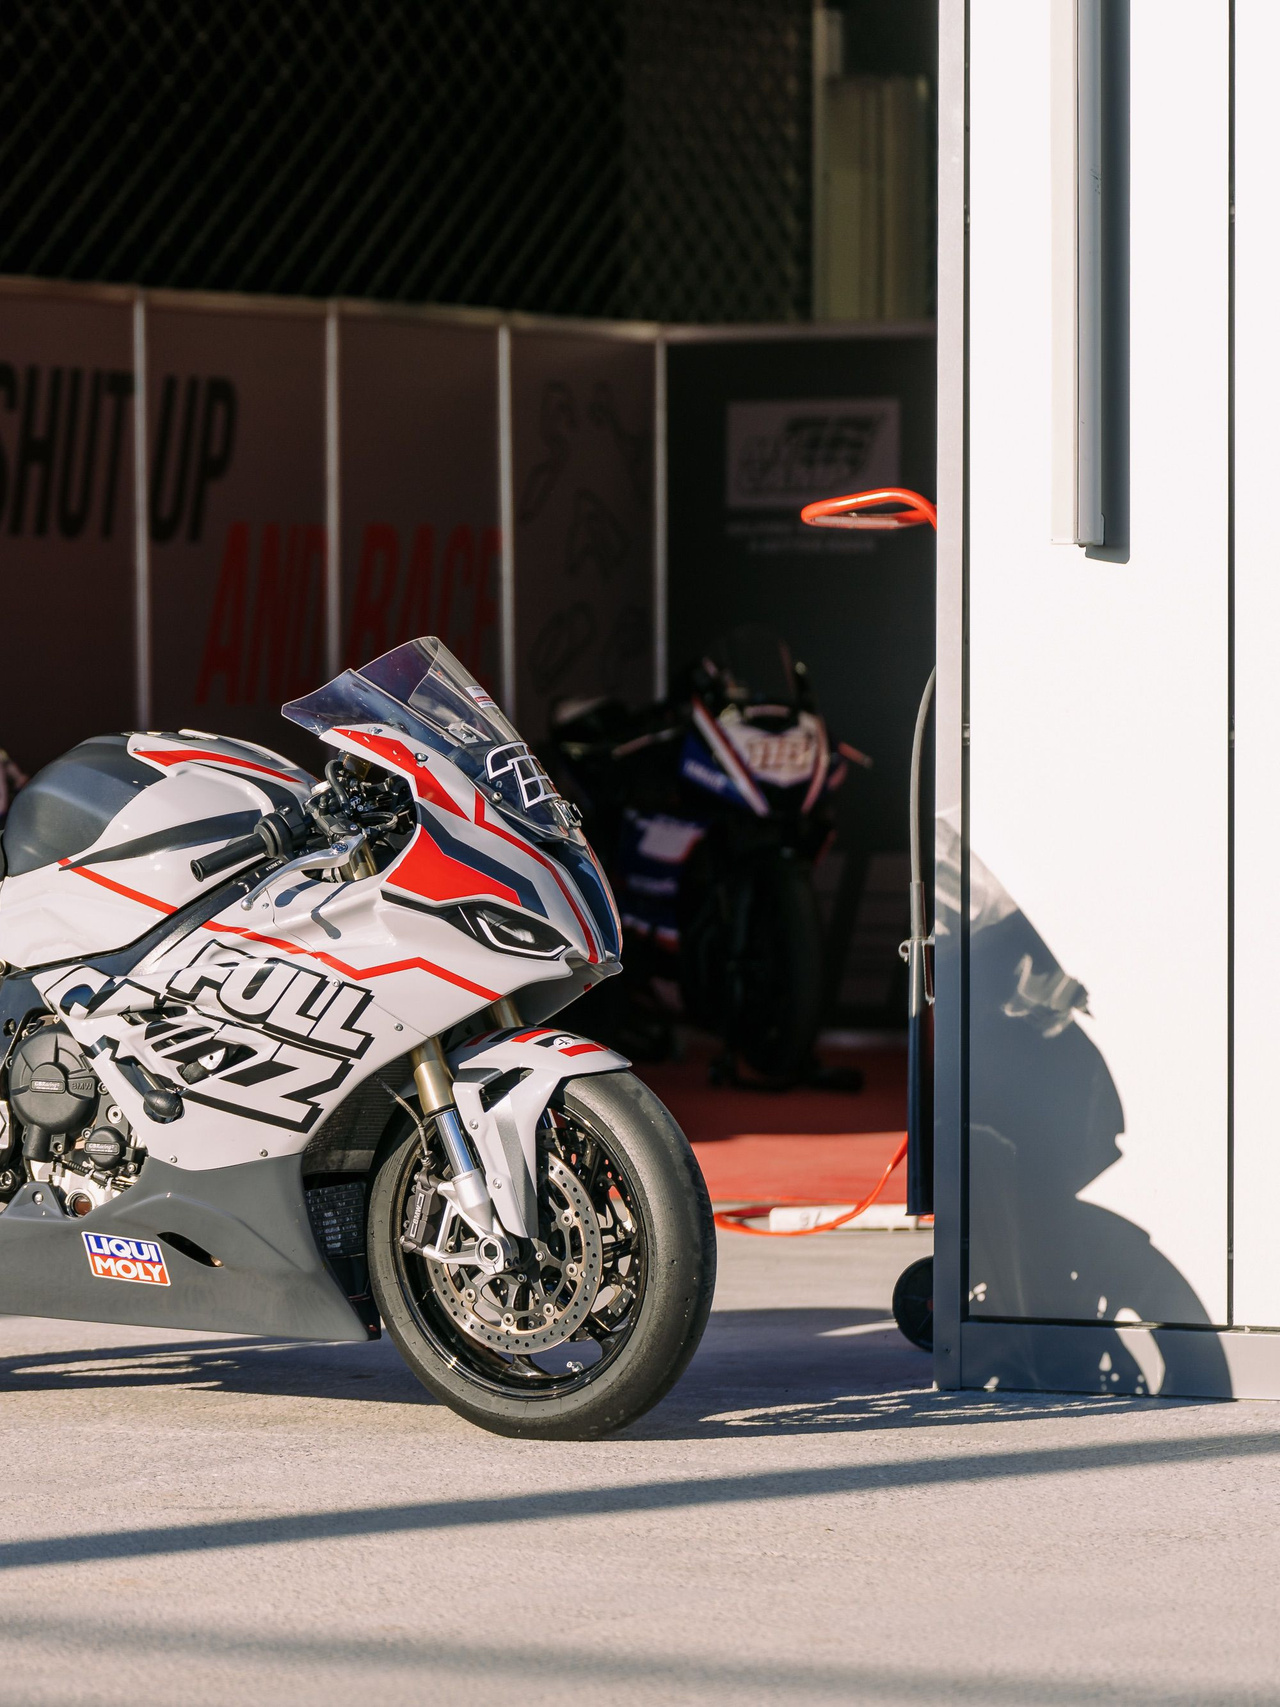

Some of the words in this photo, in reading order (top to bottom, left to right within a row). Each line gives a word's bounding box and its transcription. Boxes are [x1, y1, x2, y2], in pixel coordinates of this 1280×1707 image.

[148, 373, 240, 544] UP
[194, 520, 330, 706] AND
[165, 939, 373, 1060] FULL
[71, 1082, 94, 1091] BMW
[412, 1204, 422, 1225] BMW
[87, 1235, 160, 1262] LIQUI
[93, 1255, 164, 1282] MOLY
